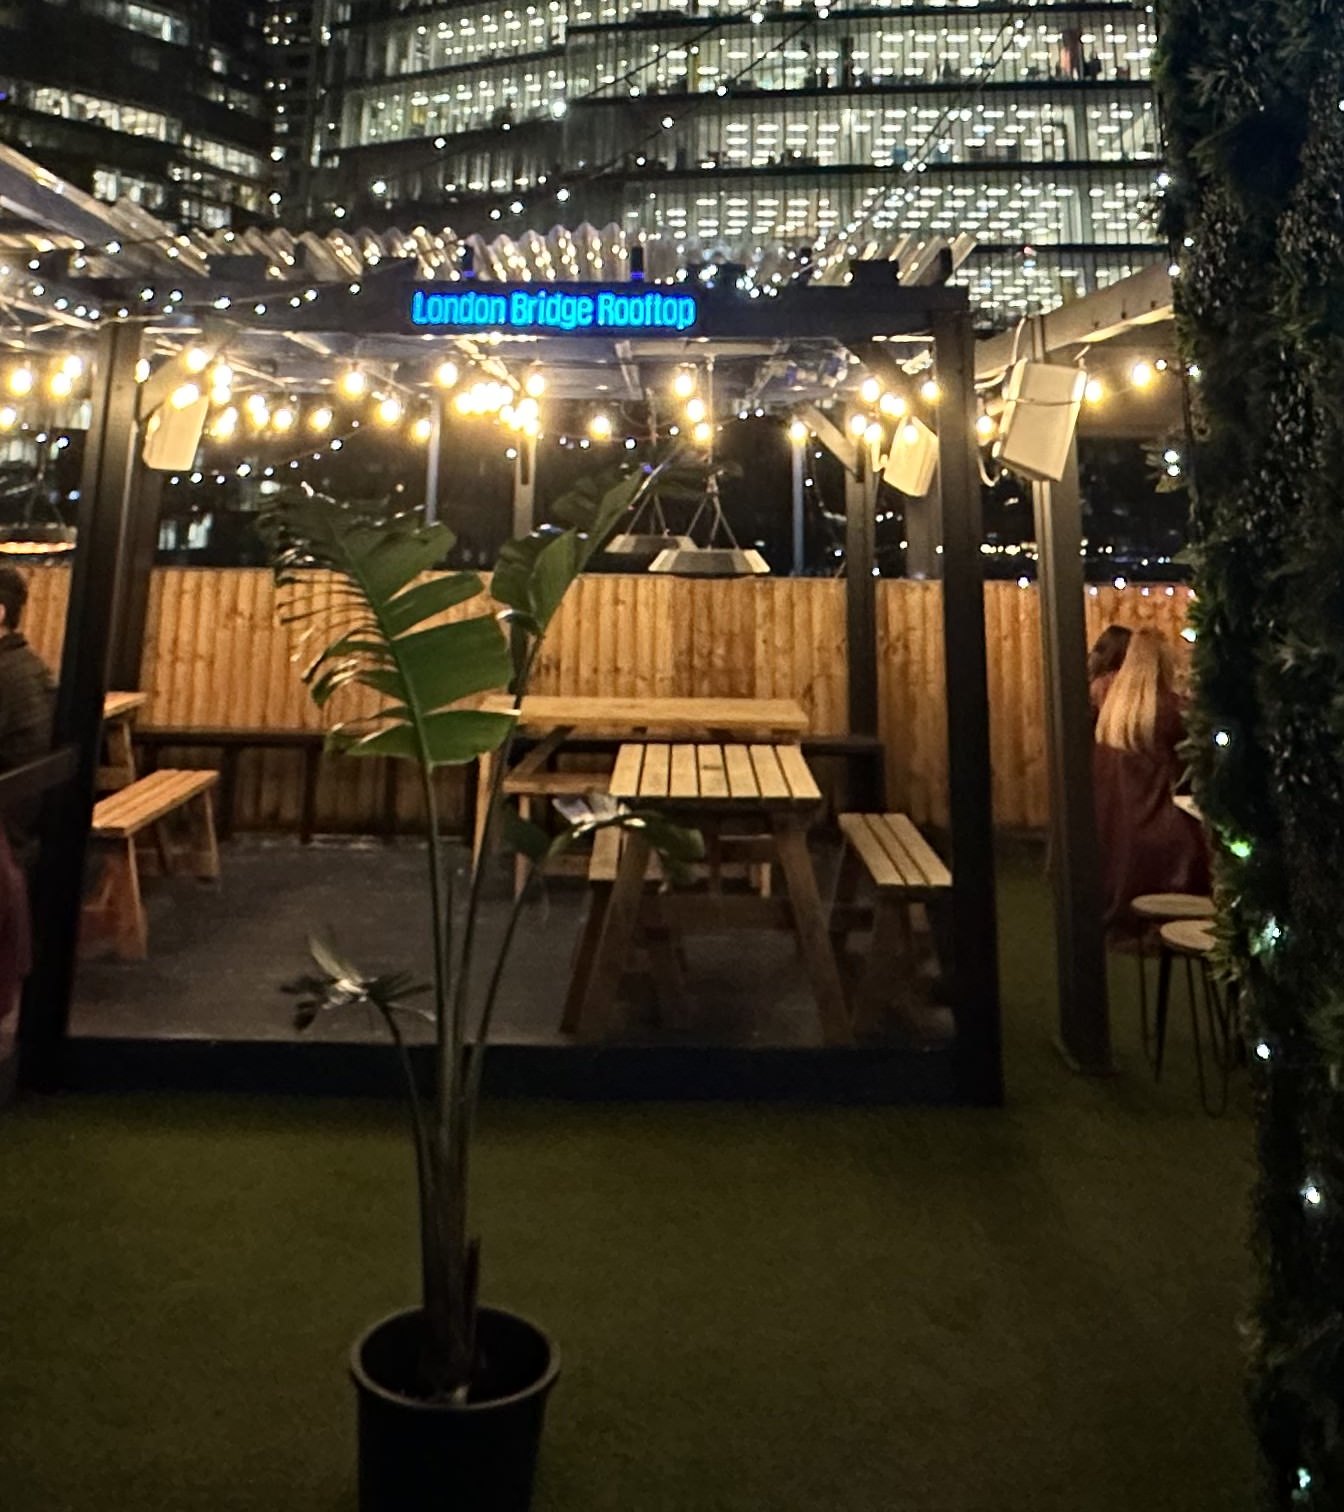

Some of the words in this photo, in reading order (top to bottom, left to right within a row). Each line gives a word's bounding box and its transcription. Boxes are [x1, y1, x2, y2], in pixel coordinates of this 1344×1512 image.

[413, 291, 505, 324] London
[510, 290, 593, 329] Bridge
[597, 292, 695, 330] Rooftop
